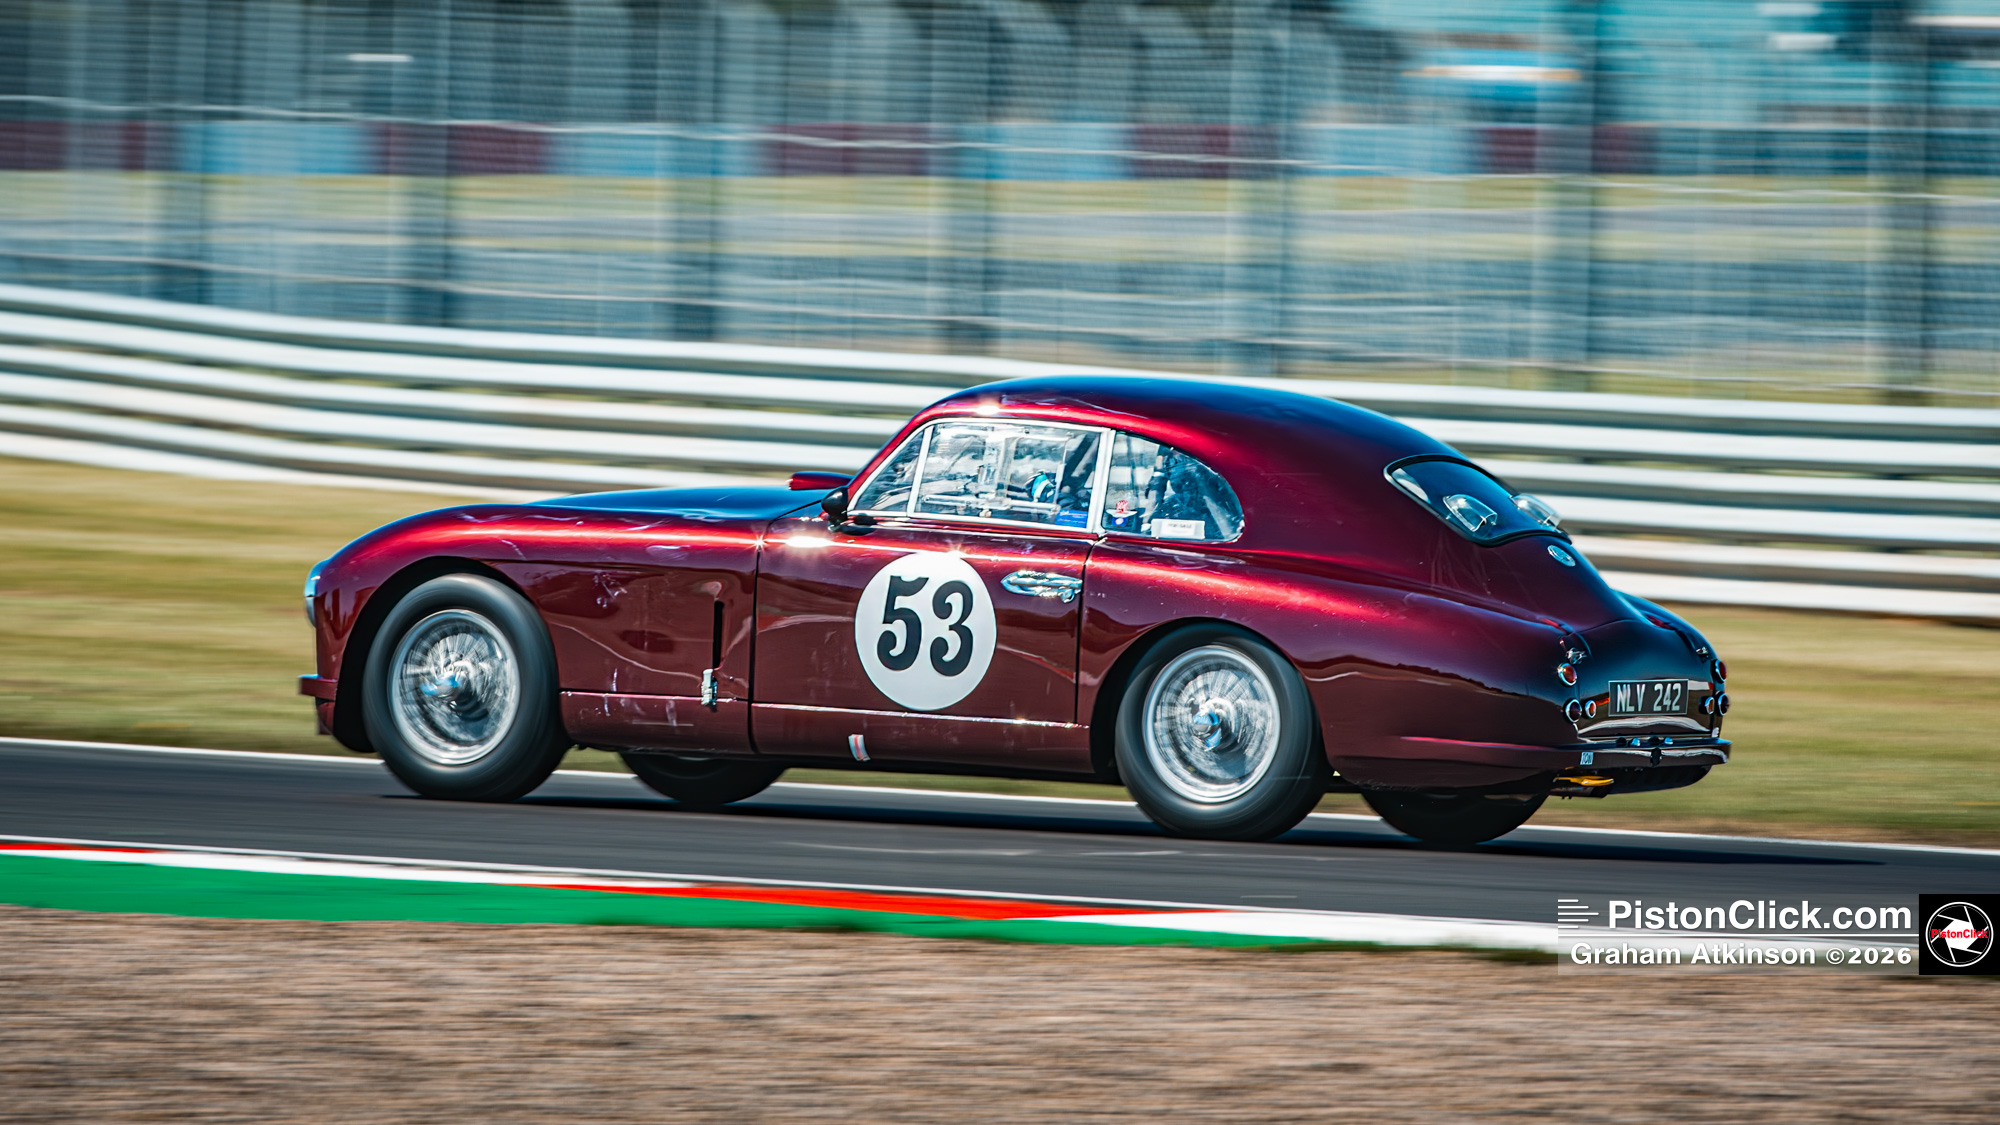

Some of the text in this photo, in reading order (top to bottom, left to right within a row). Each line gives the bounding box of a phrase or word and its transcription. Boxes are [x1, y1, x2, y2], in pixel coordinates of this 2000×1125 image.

[876, 574, 974, 677] 53
[1616, 682, 1682, 713] NLV 242
